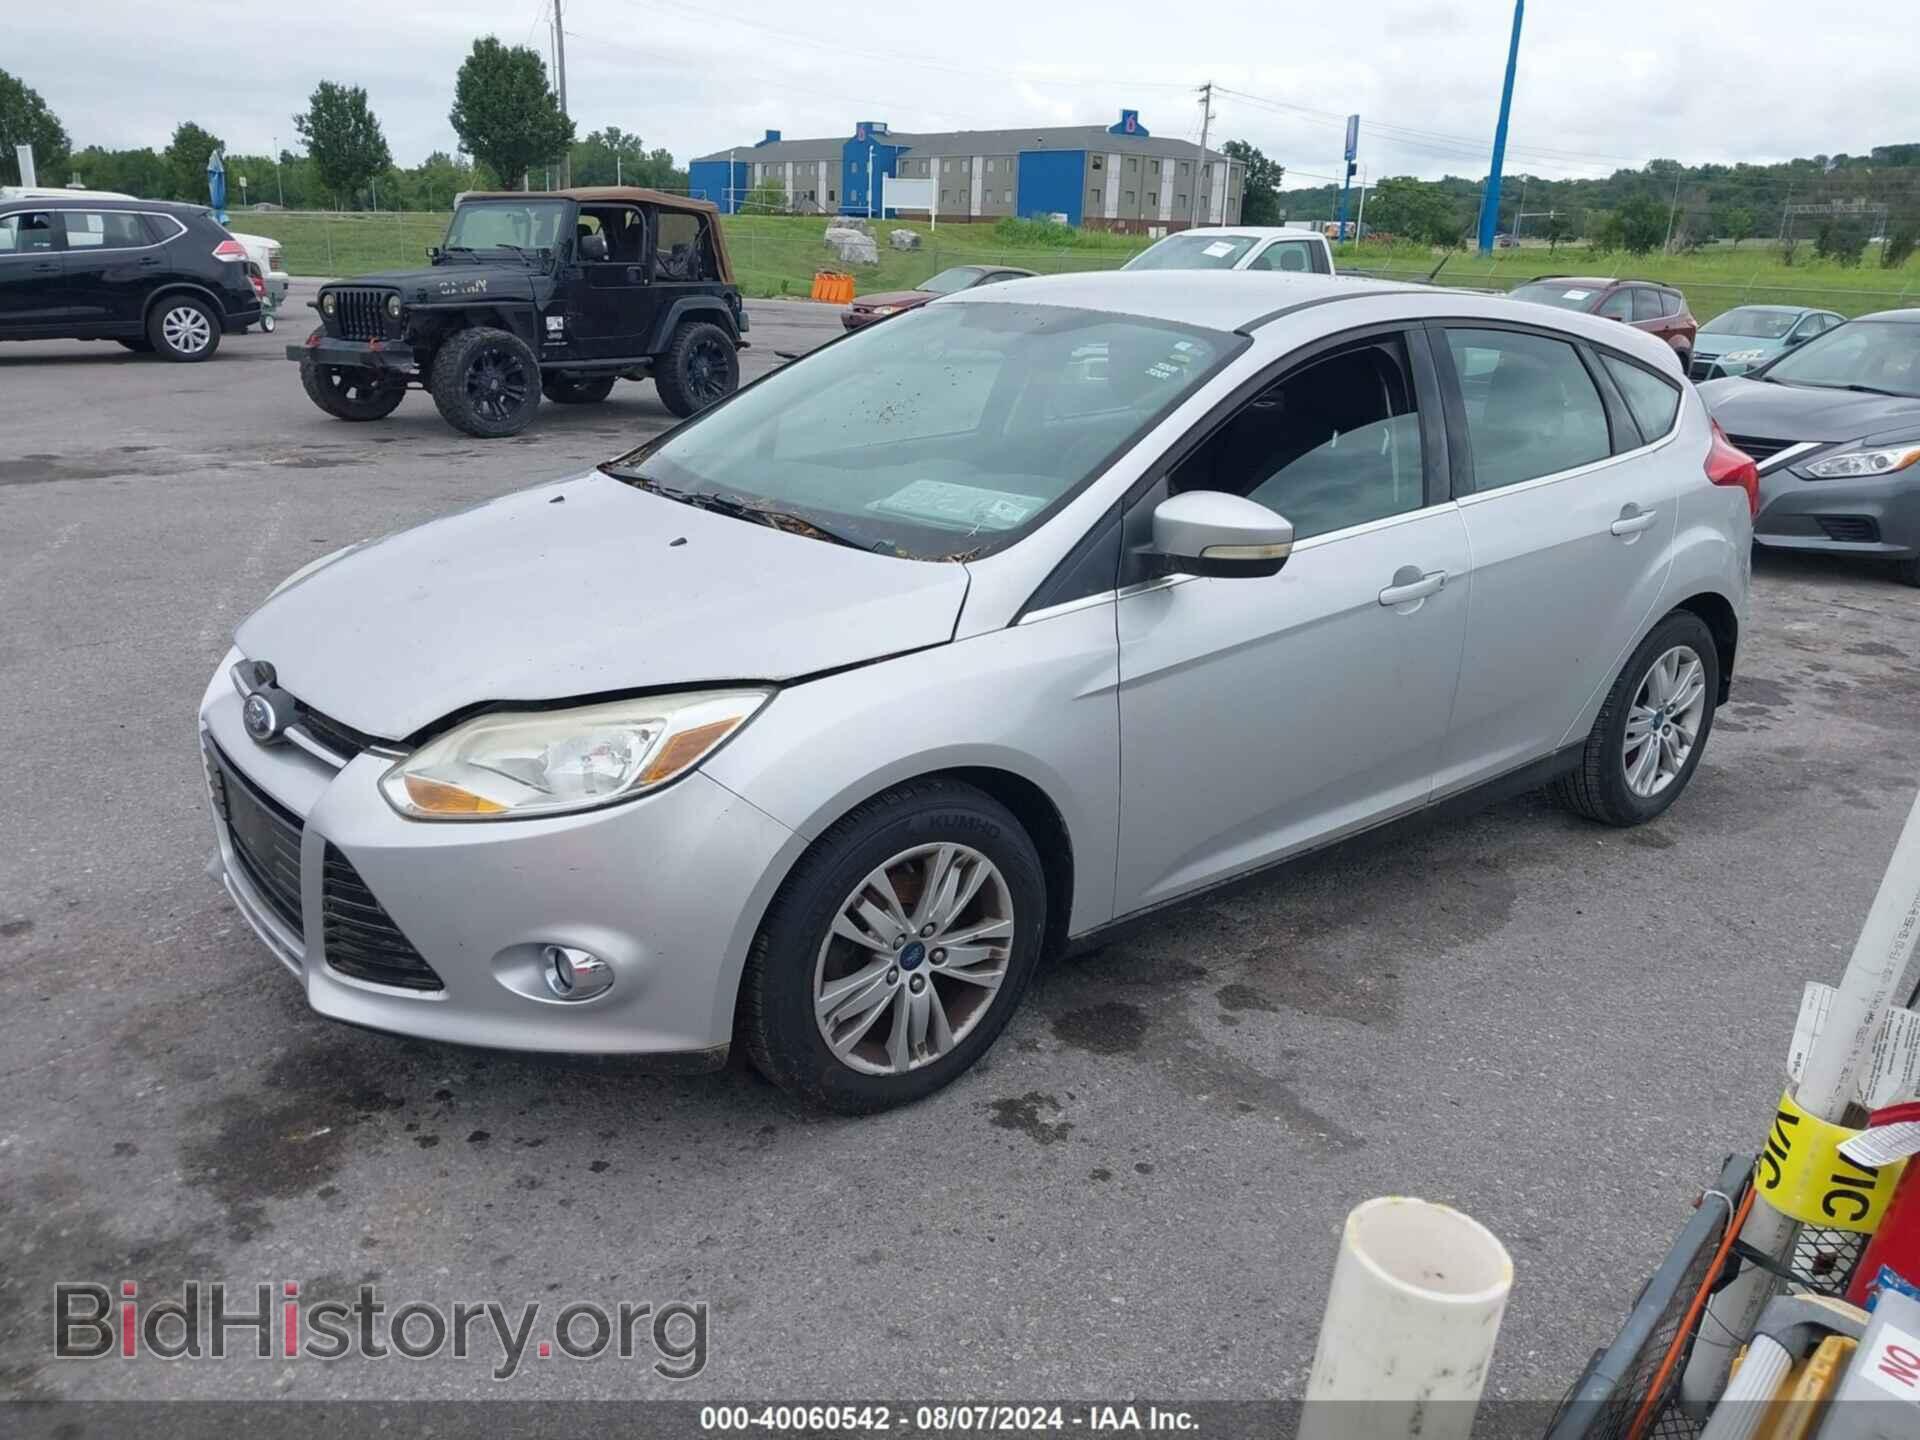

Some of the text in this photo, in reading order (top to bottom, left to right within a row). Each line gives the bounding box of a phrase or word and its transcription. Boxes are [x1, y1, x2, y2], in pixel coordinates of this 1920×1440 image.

[1126, 114, 1135, 134] 6
[929, 814, 1001, 839] KUMHO
[1757, 1111, 1800, 1190] VIC
[1878, 1344, 1920, 1388] NO
